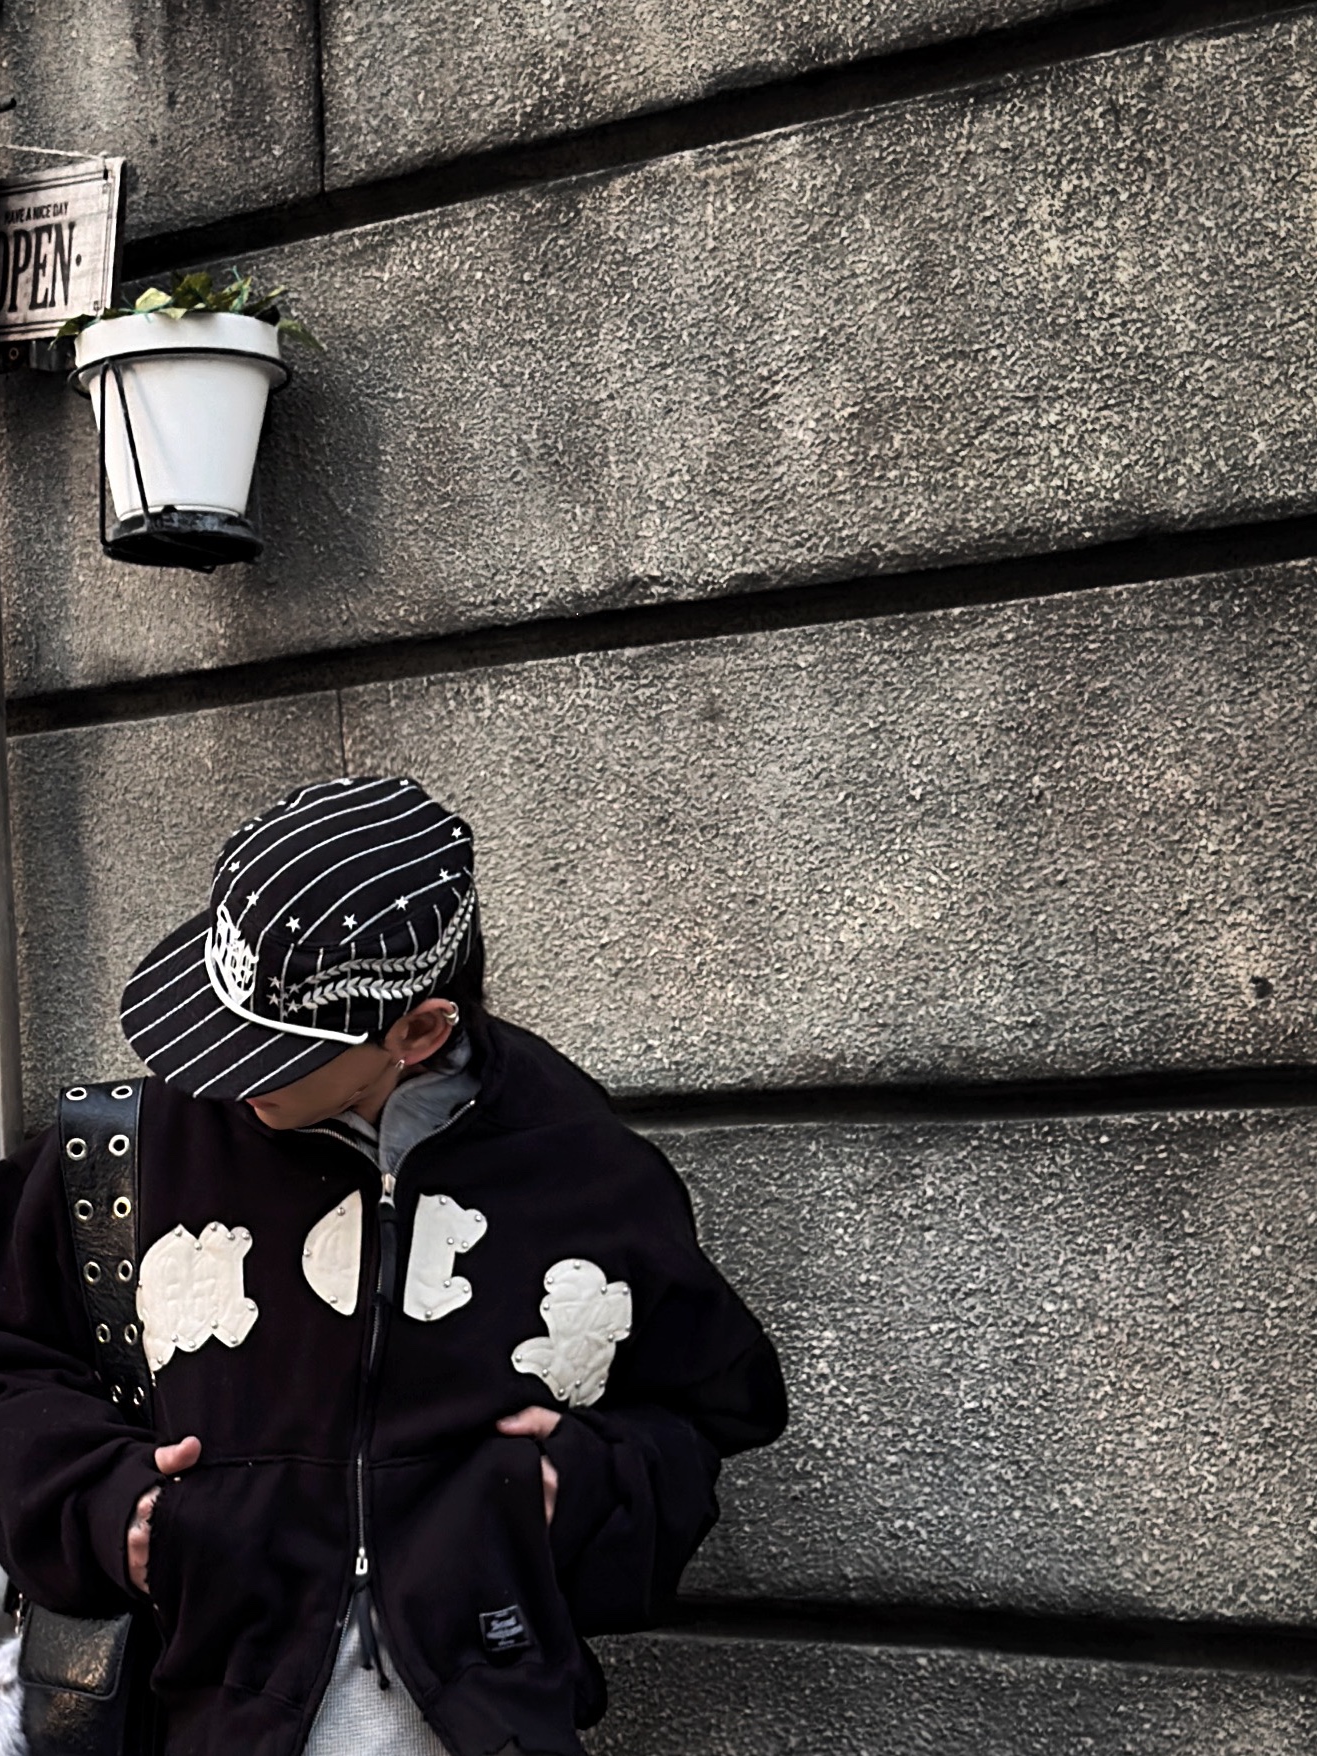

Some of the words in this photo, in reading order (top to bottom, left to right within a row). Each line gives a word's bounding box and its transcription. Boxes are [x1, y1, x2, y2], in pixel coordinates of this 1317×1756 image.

[4, 208, 26, 225] HAVE
[26, 208, 32, 219] A
[33, 204, 51, 219] NICE
[53, 202, 69, 217] DAY
